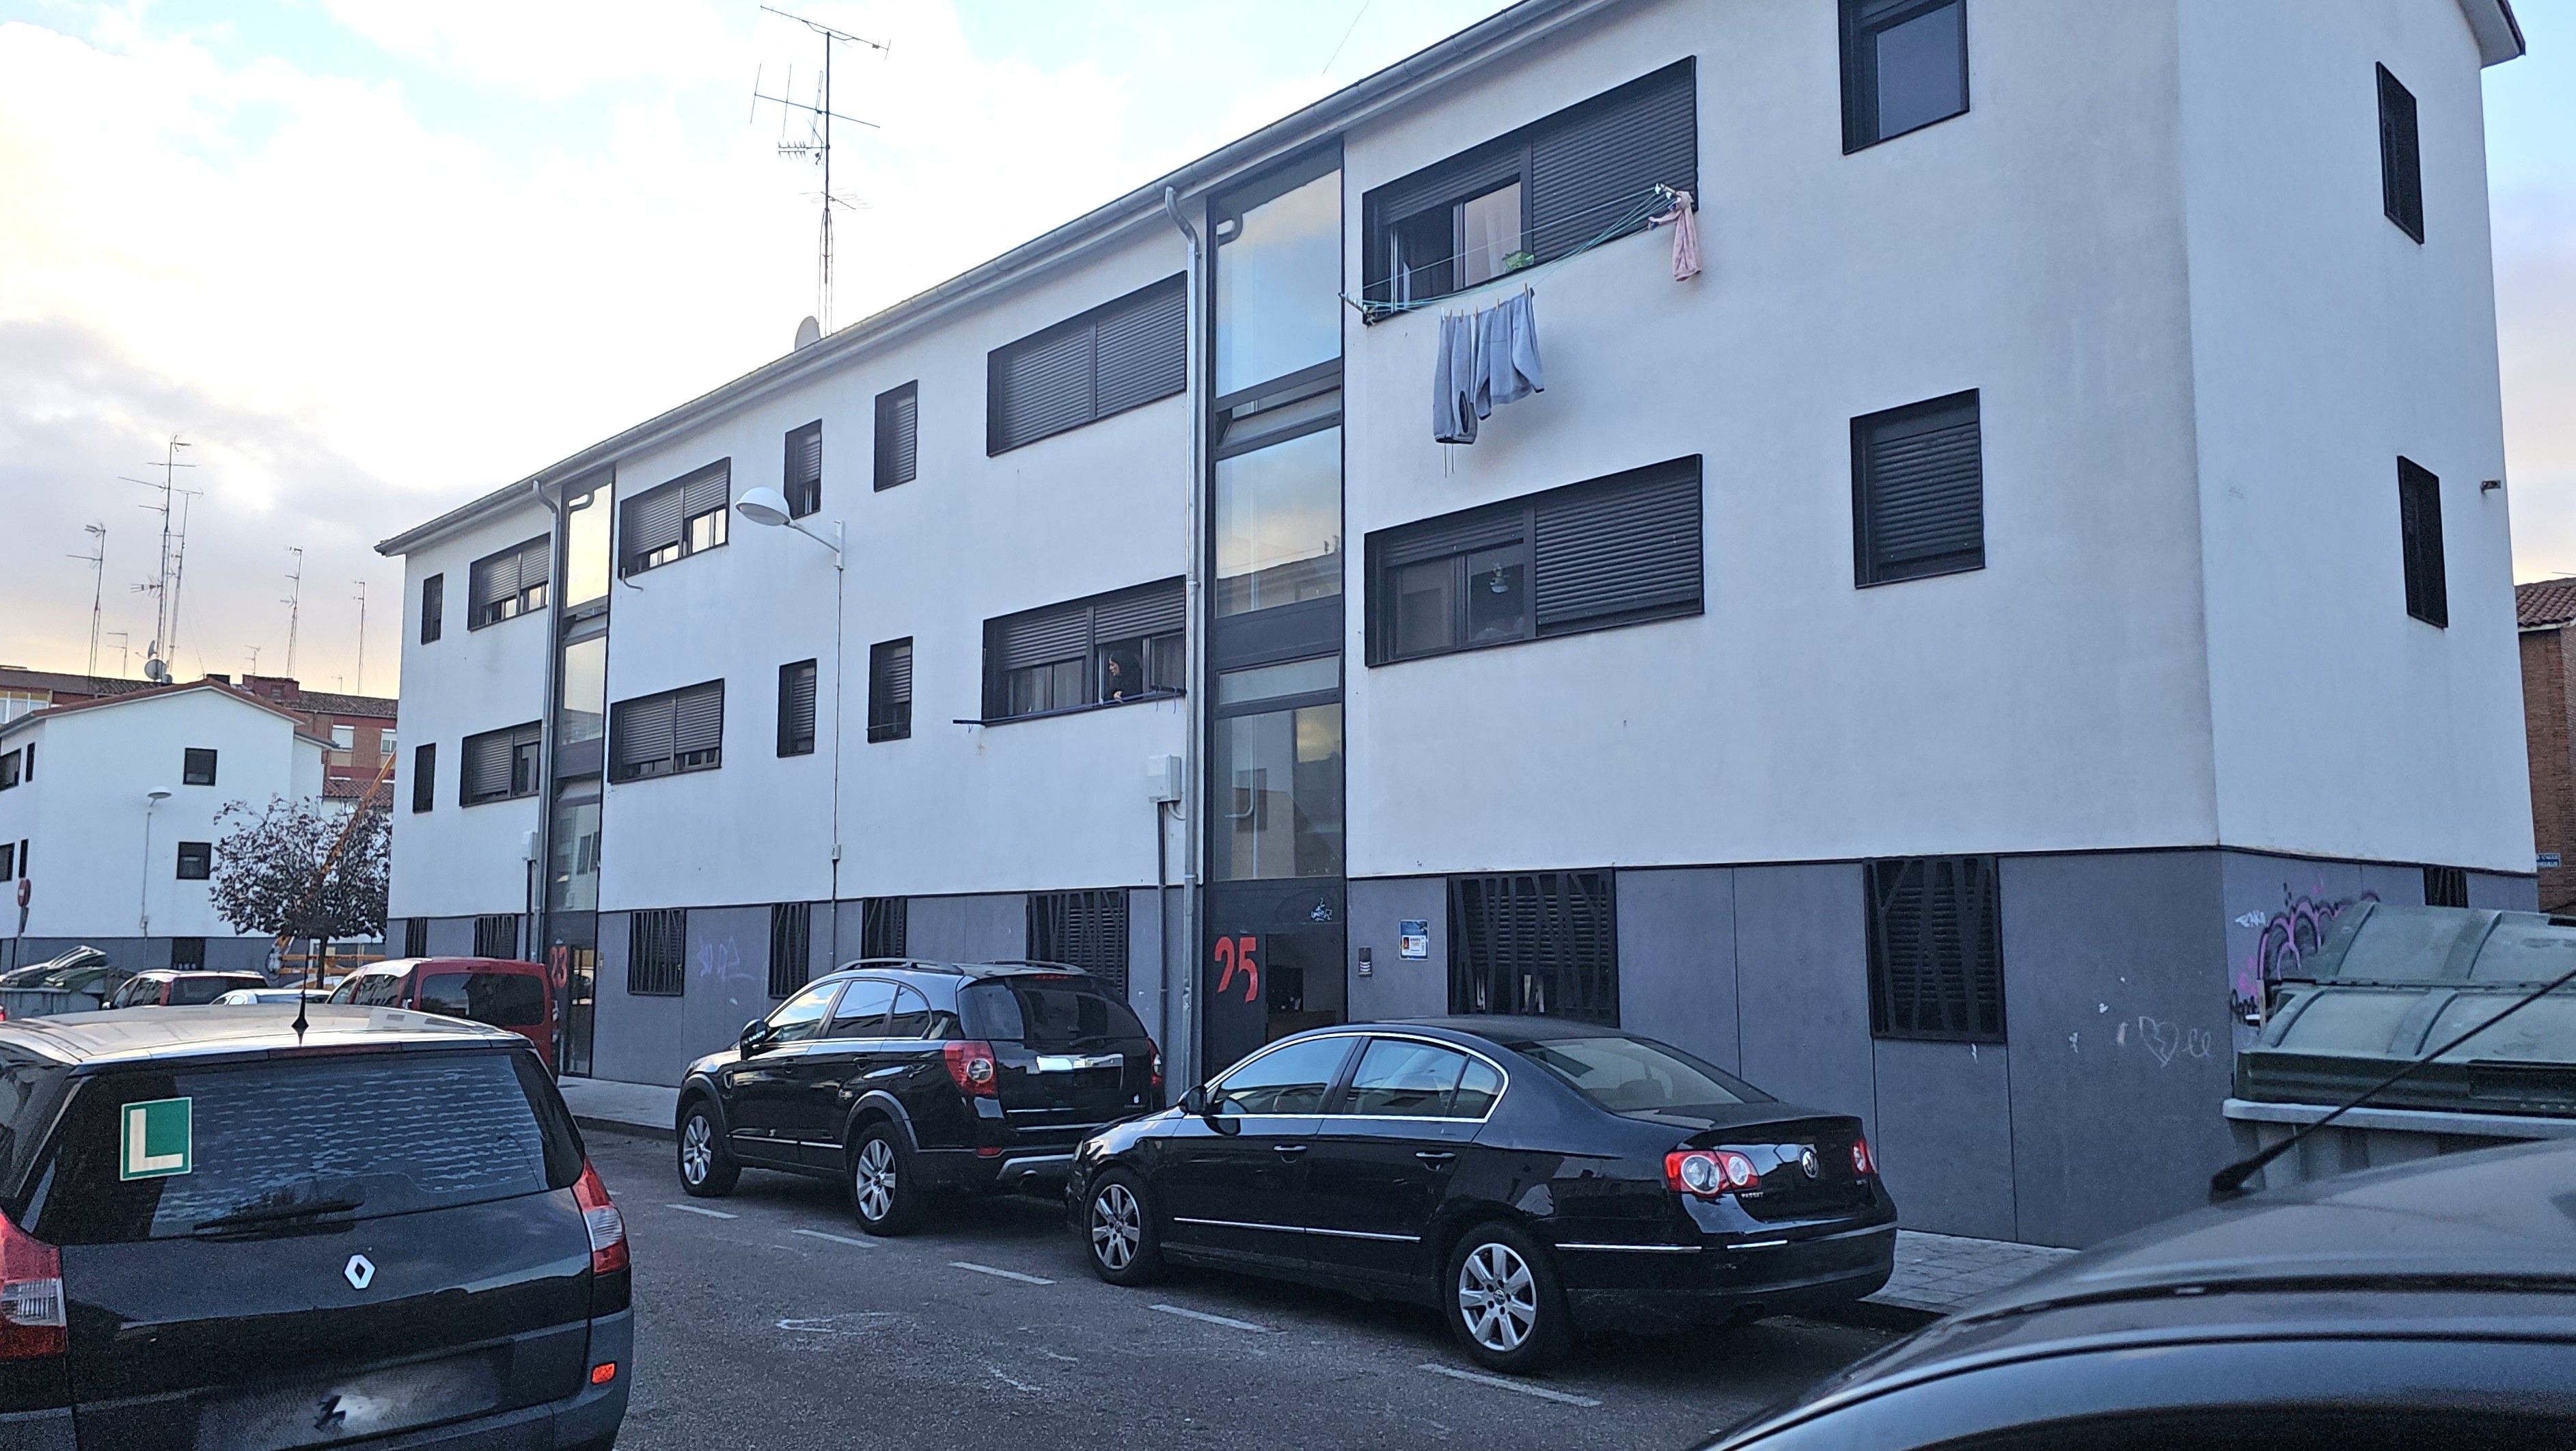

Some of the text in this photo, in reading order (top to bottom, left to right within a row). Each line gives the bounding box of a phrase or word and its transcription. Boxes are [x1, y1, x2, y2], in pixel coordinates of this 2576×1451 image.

[549, 947, 567, 988] 23
[1215, 936, 1258, 1003] 25
[128, 1108, 183, 1174] L
